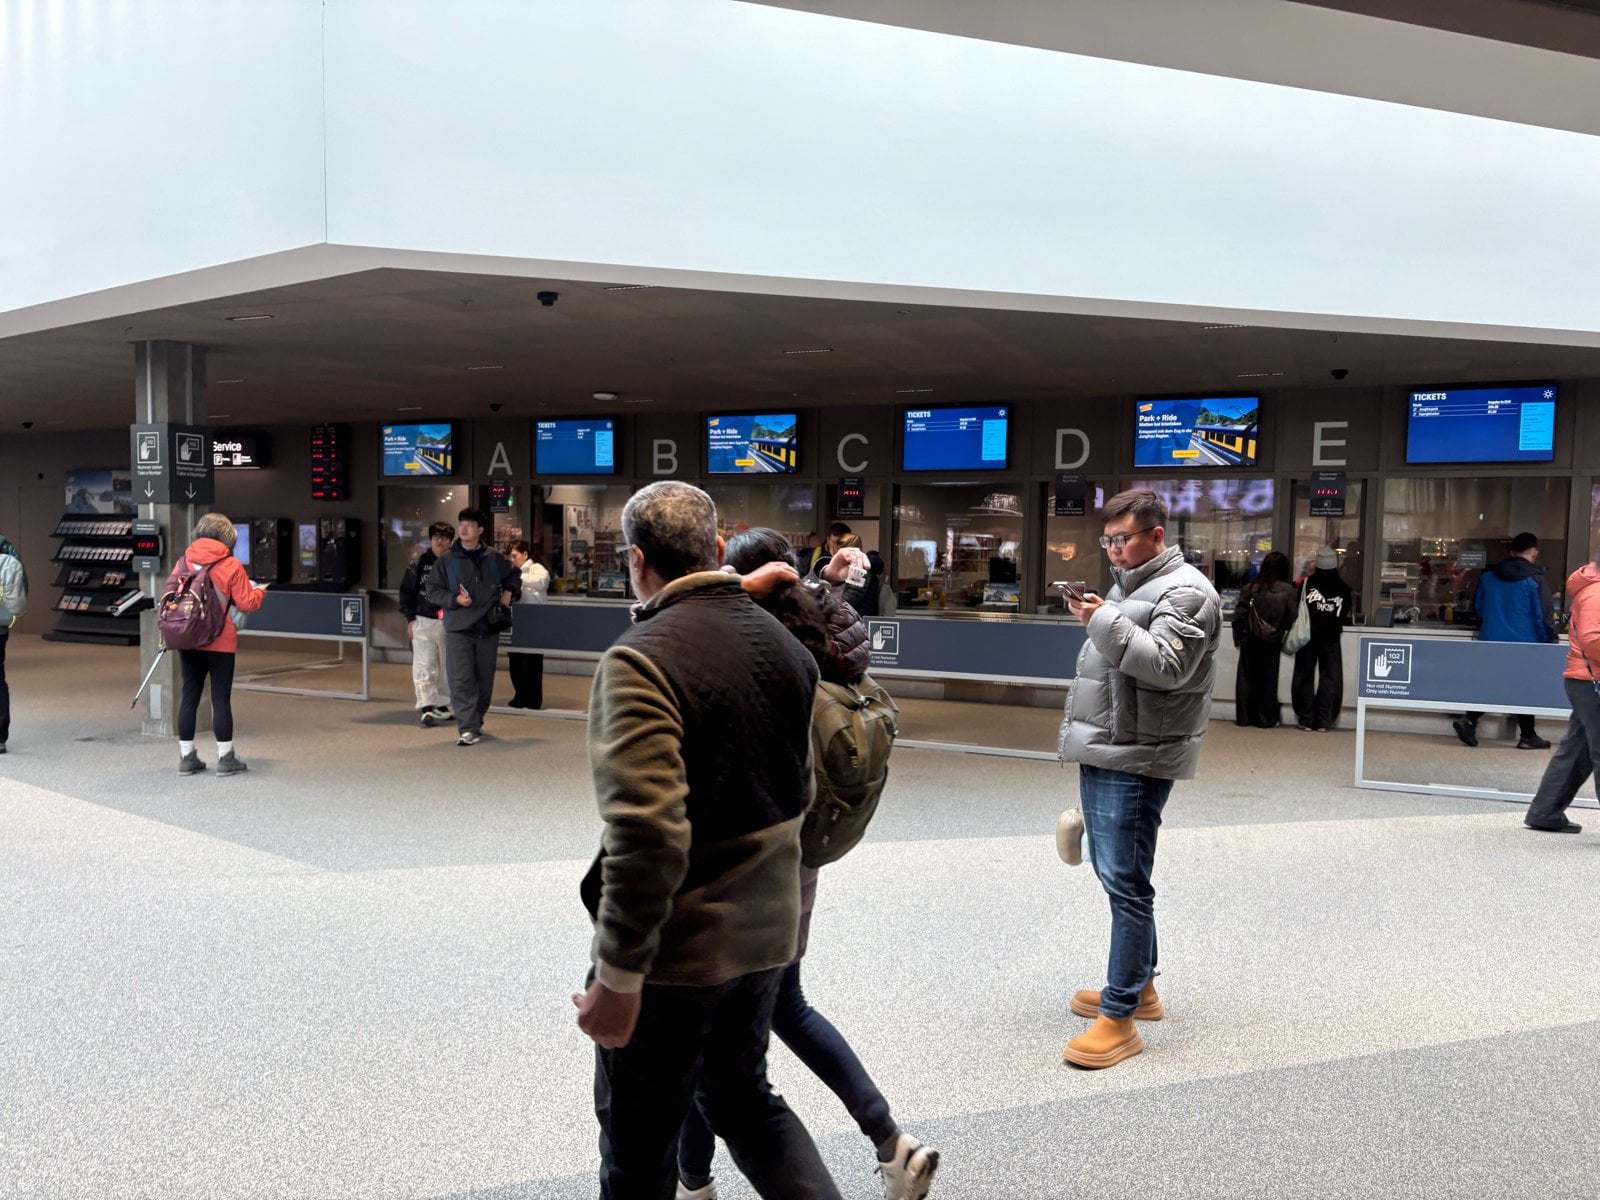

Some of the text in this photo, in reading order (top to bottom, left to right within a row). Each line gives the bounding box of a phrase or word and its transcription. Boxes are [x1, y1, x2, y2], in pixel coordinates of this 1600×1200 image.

[1413, 393, 1447, 401] TICKETS
[213, 441, 242, 452] Service
[488, 442, 512, 475] A
[652, 439, 678, 475] B
[837, 433, 869, 472] C
[1054, 428, 1090, 470] D
[1312, 422, 1348, 466] E
